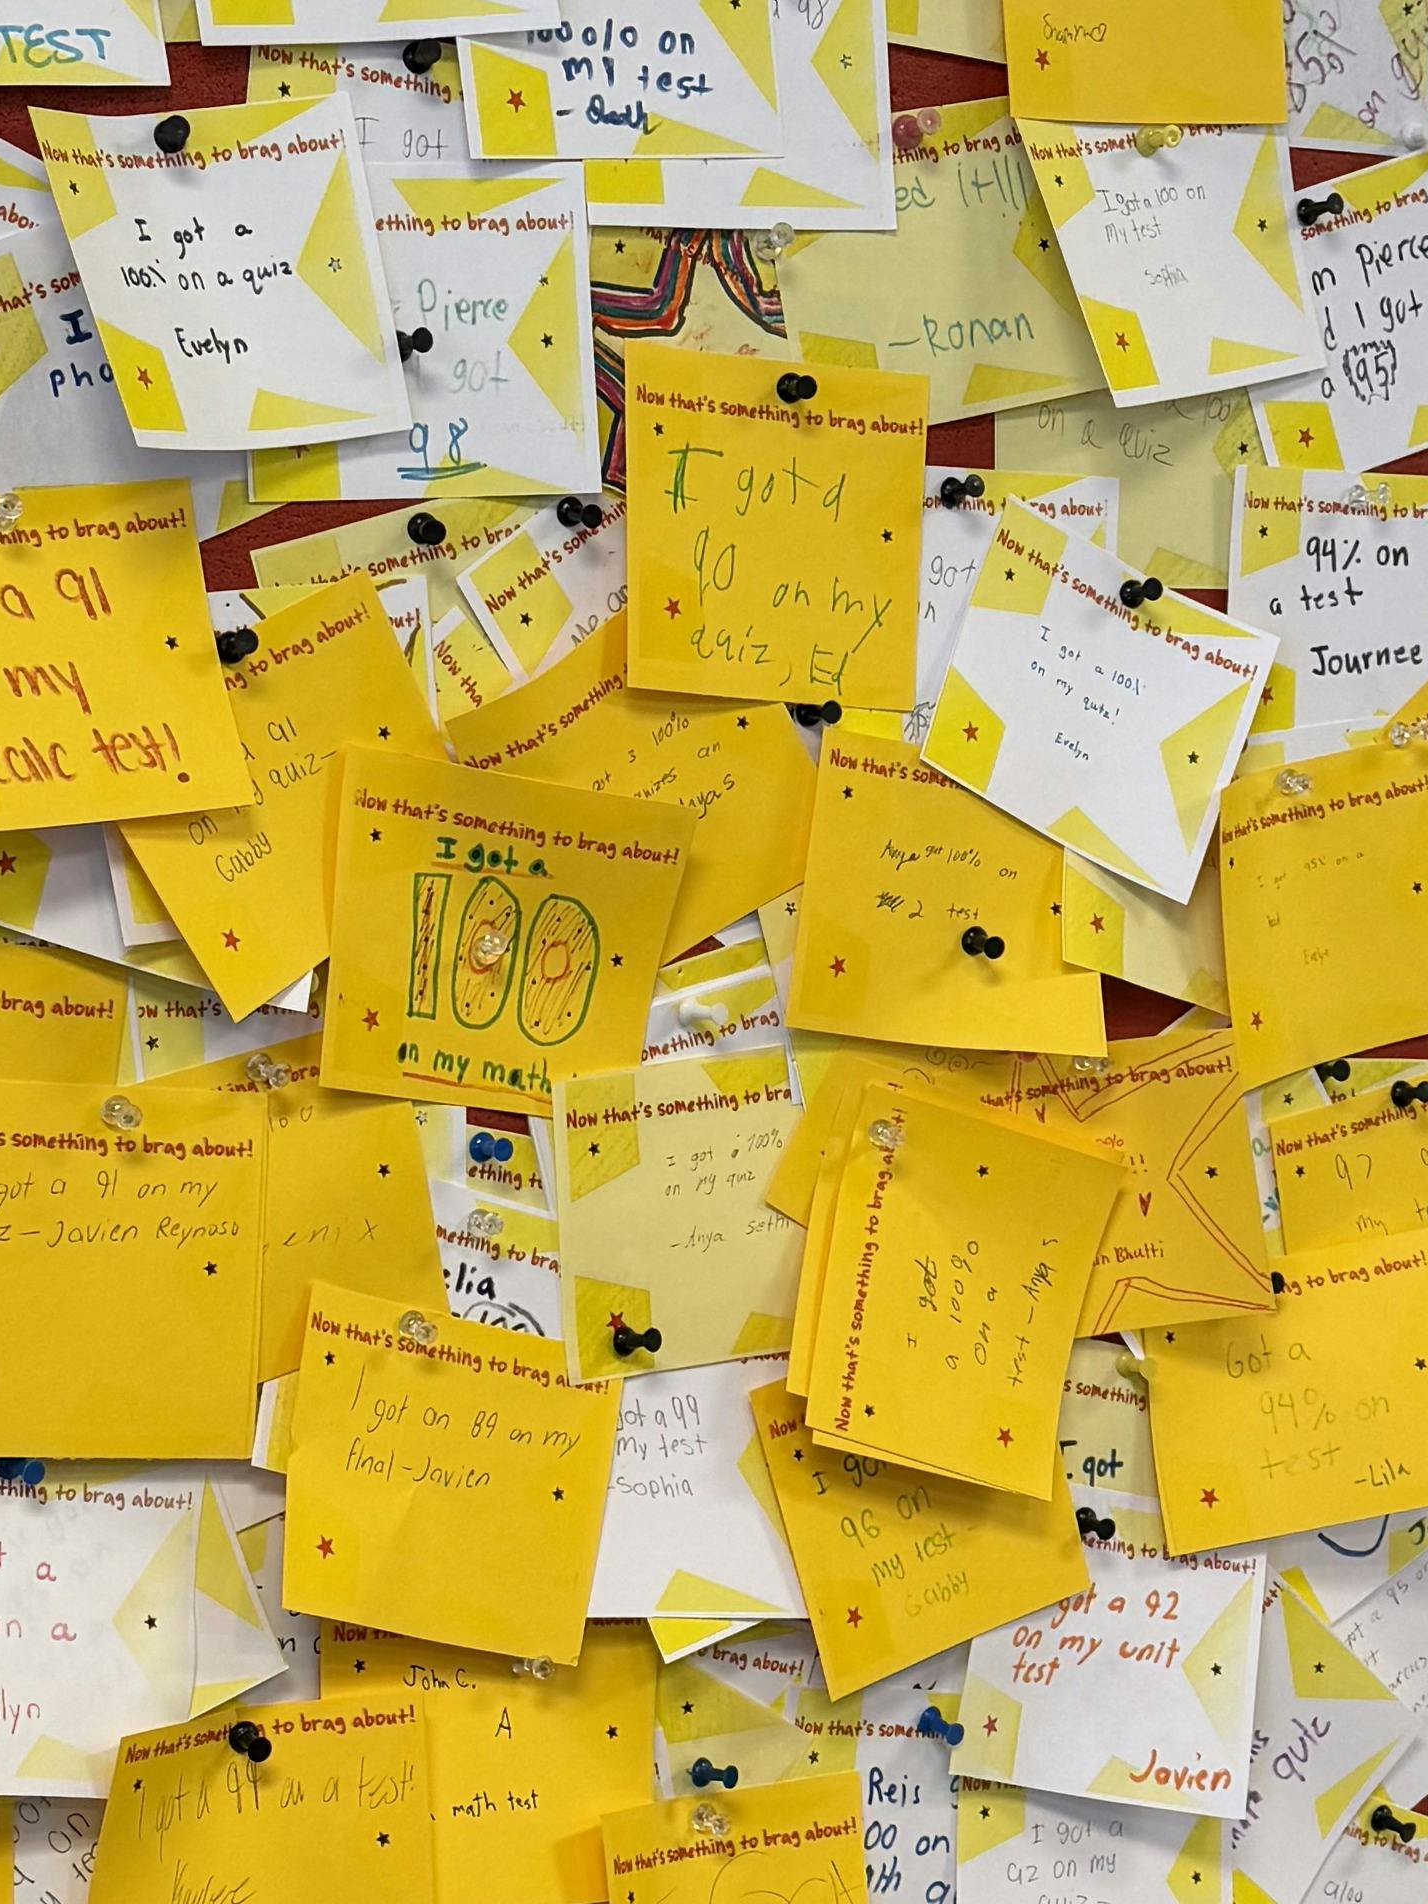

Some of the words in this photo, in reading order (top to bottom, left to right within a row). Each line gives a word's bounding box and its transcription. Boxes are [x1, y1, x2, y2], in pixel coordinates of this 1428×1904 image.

[42, 138, 70, 161] Now
[72, 146, 114, 168] that's
[117, 145, 206, 171] something
[211, 145, 232, 164] to
[236, 140, 282, 166] brag
[287, 130, 344, 154] about!
[134, 218, 151, 242] I
[173, 218, 204, 258] got
[234, 222, 252, 237] a
[178, 267, 204, 291] on
[218, 272, 233, 286] a
[242, 260, 292, 294] quiz
[176, 328, 248, 364] Evelyn
[47, 524, 70, 544] to
[75, 519, 121, 544] brag
[126, 507, 187, 534] about!
[1306, 536, 1361, 572] 94%
[1377, 544, 1409, 567] on
[0, 584, 32, 622] a
[55, 567, 112, 617] 91
[1269, 595, 1283, 616] a
[1300, 578, 1364, 611] test
[1310, 643, 1423, 678] Journee
[4, 661, 92, 717] my
[92, 724, 190, 784] test!
[1051, 1583, 1096, 1628] got
[1109, 1597, 1125, 1616] a
[1144, 1591, 1180, 1620] 92
[1013, 1628, 1043, 1650] on
[1061, 1632, 1102, 1664] my
[1119, 1637, 1180, 1667] unit
[1012, 1653, 1061, 1686] test
